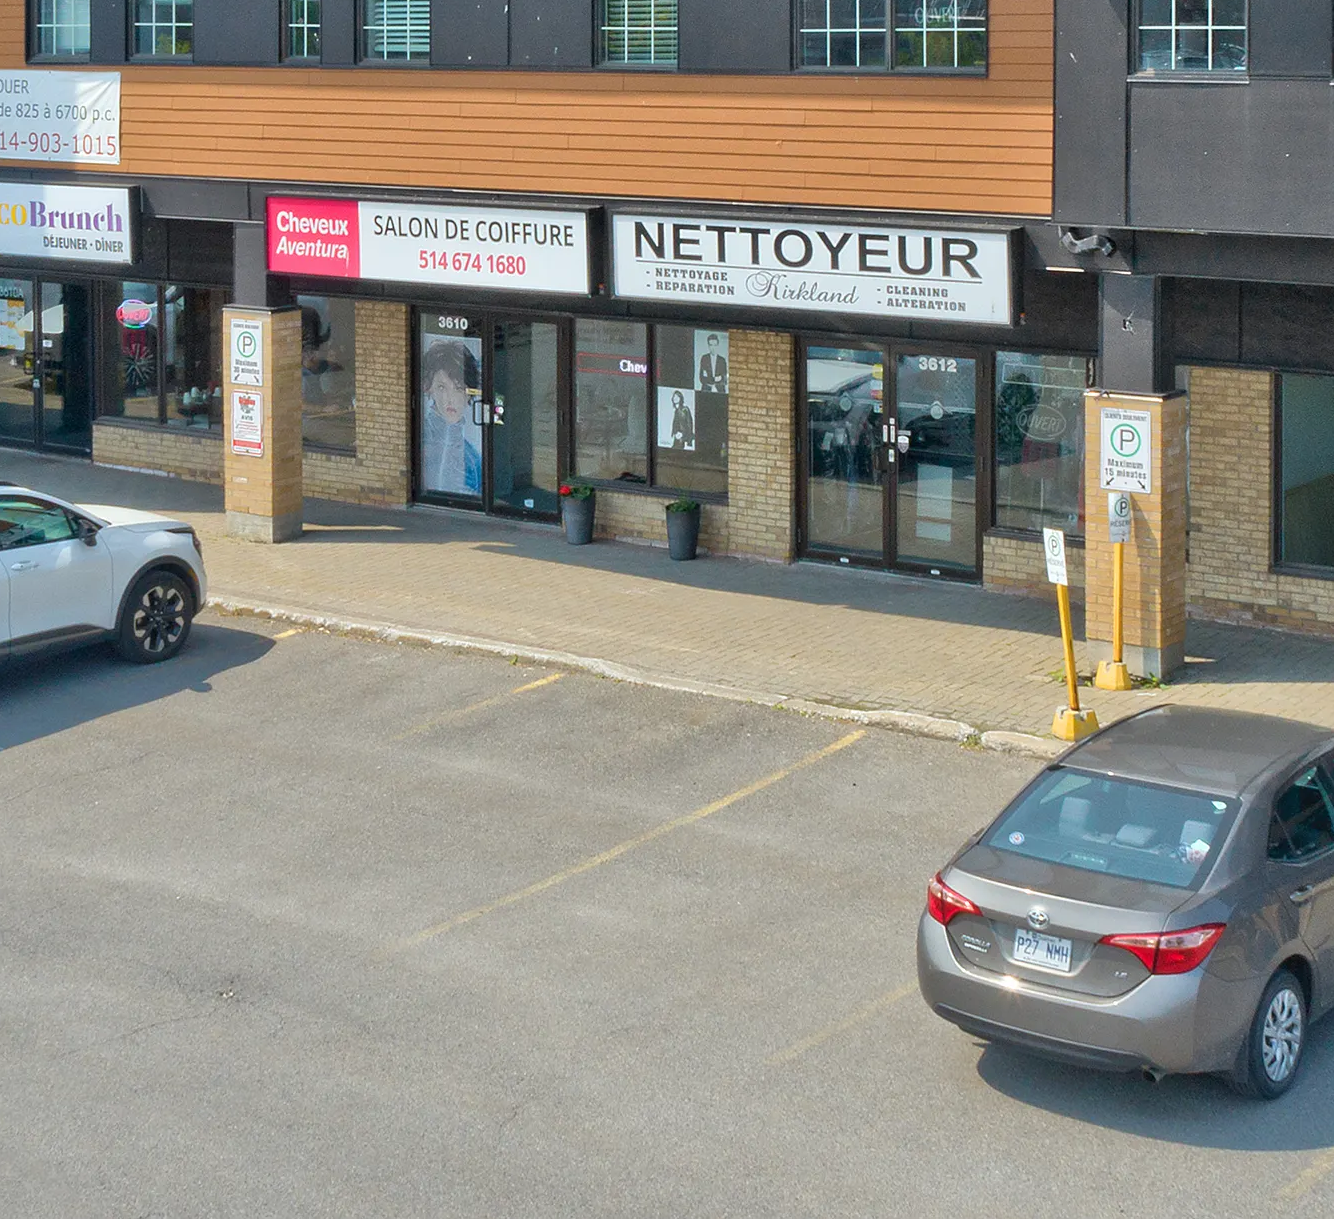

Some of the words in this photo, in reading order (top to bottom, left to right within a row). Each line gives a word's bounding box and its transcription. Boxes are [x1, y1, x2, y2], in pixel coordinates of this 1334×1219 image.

[16, 103, 40, 119] 825
[43, 103, 51, 119] à
[55, 105, 88, 120] 6700
[92, 108, 116, 124] p.c.
[276, 211, 349, 236] Cheveux
[373, 215, 438, 238] SALON
[445, 219, 469, 240] DE
[476, 220, 574, 247] COIFFURE
[43, 234, 88, 250] DÉJEUNER
[95, 238, 124, 253] DÎNER
[276, 236, 349, 259] Aventura
[633, 221, 982, 279] NETTOYEUR
[419, 250, 448, 271] 514
[452, 252, 482, 273] 674
[486, 255, 526, 276] 1680
[655, 267, 728, 282] NETTOYAGE
[655, 280, 735, 295] REPARATION
[745, 271, 860, 305] Kirkland
[886, 285, 949, 298] CLEANING
[886, 298, 967, 312] ALTERATION
[438, 316, 468, 330] 3610
[918, 356, 958, 373] 3612
[1119, 428, 1135, 451] P
[1105, 467, 1115, 477] 15
[1116, 468, 1147, 480] minutes
[1107, 458, 1144, 470] Maximum
[1016, 936, 1040, 956] P27
